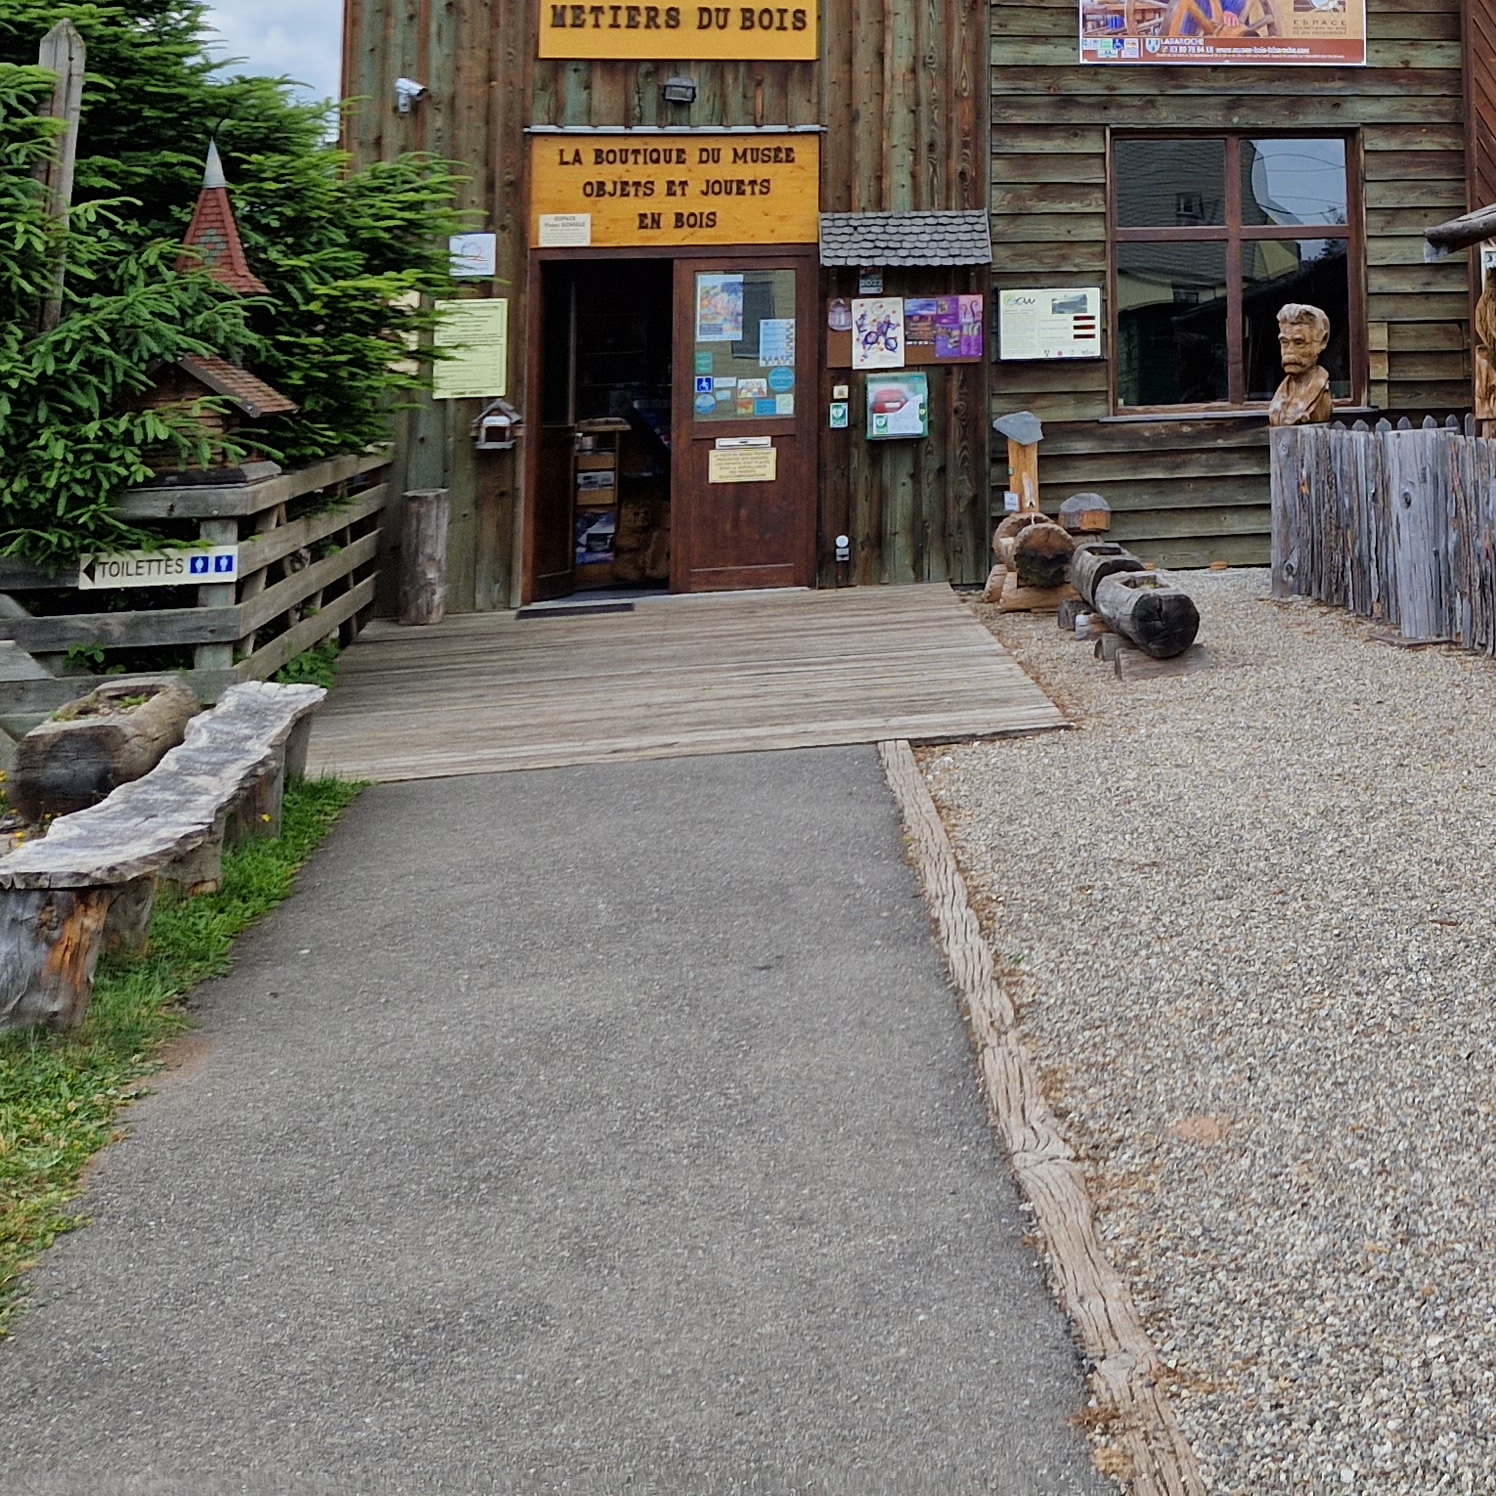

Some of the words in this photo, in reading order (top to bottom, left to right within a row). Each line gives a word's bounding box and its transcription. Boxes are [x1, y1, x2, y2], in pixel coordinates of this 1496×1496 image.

[550, 4, 681, 29] METIERS
[697, 7, 731, 30] DU
[740, 8, 807, 31] BOIS
[558, 148, 582, 166] LA
[593, 148, 687, 165] BOUTIQUE
[697, 148, 722, 164] DU
[582, 180, 655, 198] OBJETS
[665, 180, 689, 197] ET
[700, 179, 771, 196] JOUETS
[637, 213, 662, 230] EN
[674, 212, 717, 229] BOIS
[100, 558, 184, 578] TOILETTES
